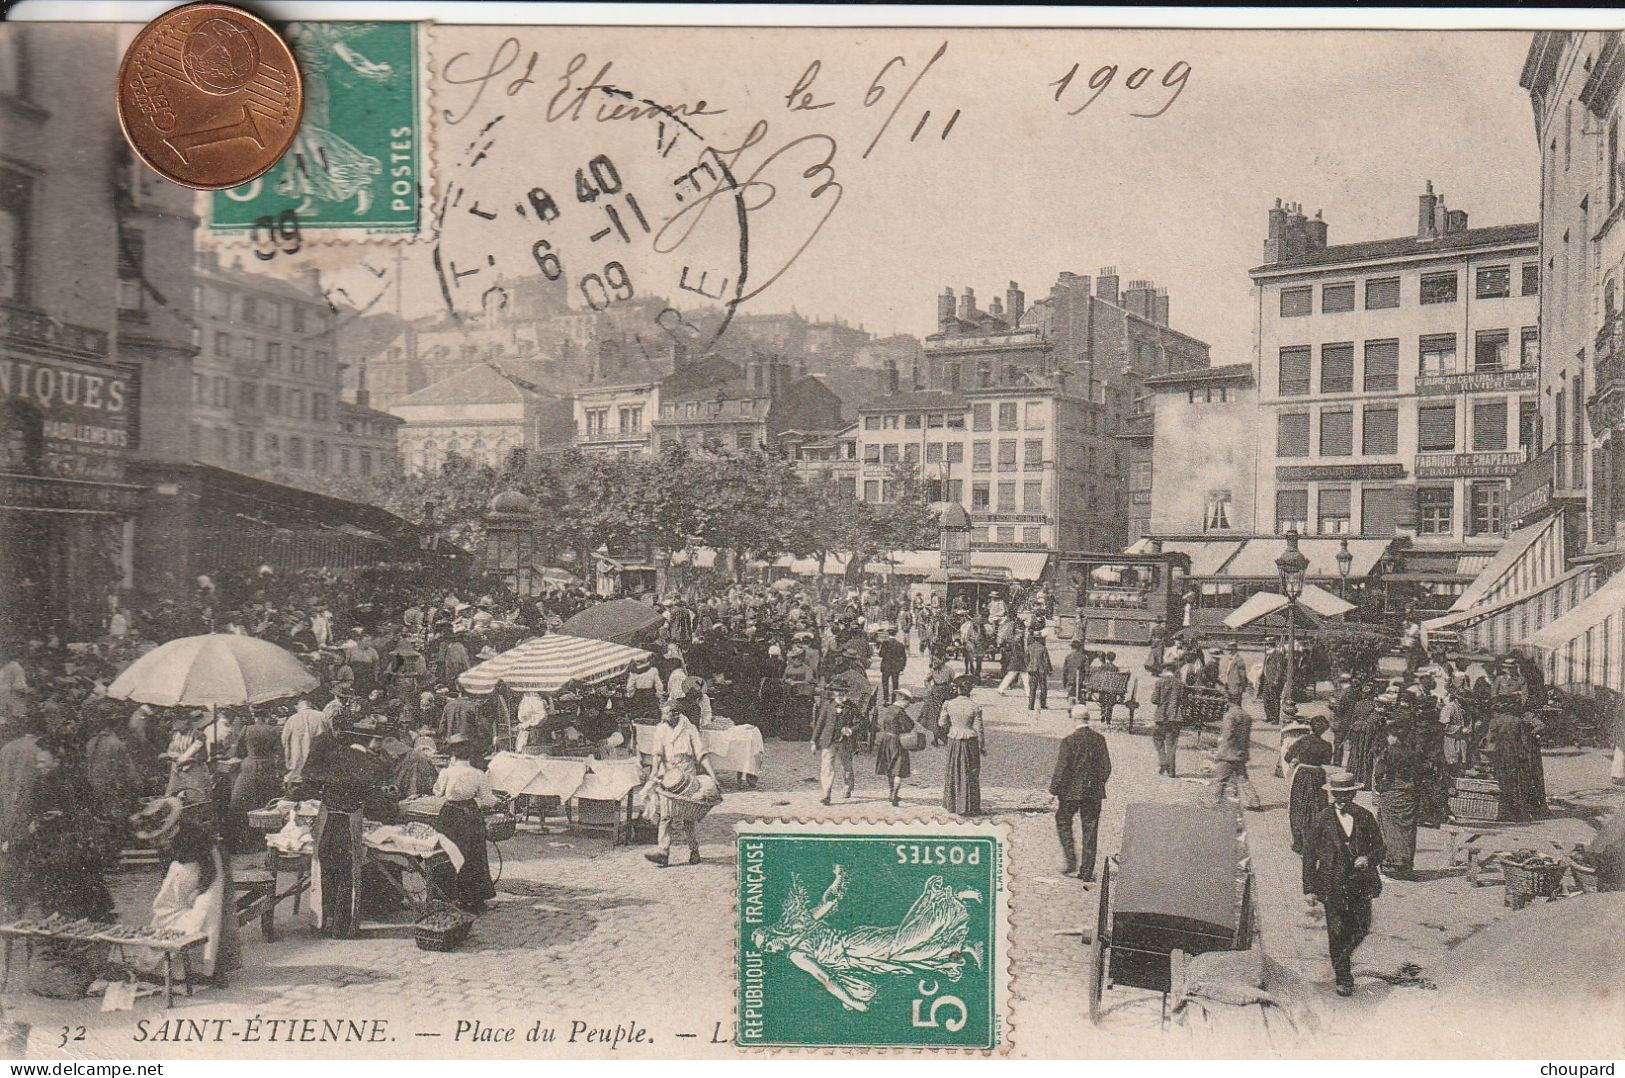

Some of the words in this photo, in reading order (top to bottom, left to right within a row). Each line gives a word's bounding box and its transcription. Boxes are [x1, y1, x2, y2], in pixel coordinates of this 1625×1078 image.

[138, 72, 177, 134] CENT
[786, 60, 836, 111] le
[1049, 60, 1192, 119] 1909
[390, 125, 413, 212] POSTES
[575, 153, 623, 203] 40
[580, 261, 634, 312] 09
[1424, 375, 1456, 386] BUREAU
[1457, 373, 1496, 384] CENTRAL
[1415, 454, 1457, 468] FABRIQUE
[1473, 453, 1521, 466] CHAPEAUX
[897, 845, 980, 865] POSTES
[746, 841, 766, 924] FRANÇAISE
[58, 1025, 87, 1048] 32
[133, 1014, 396, 1042] SAINT-ÉTIENNE.
[454, 1020, 515, 1043] Place
[526, 1020, 556, 1043] du
[568, 1020, 655, 1050] Peuple.
